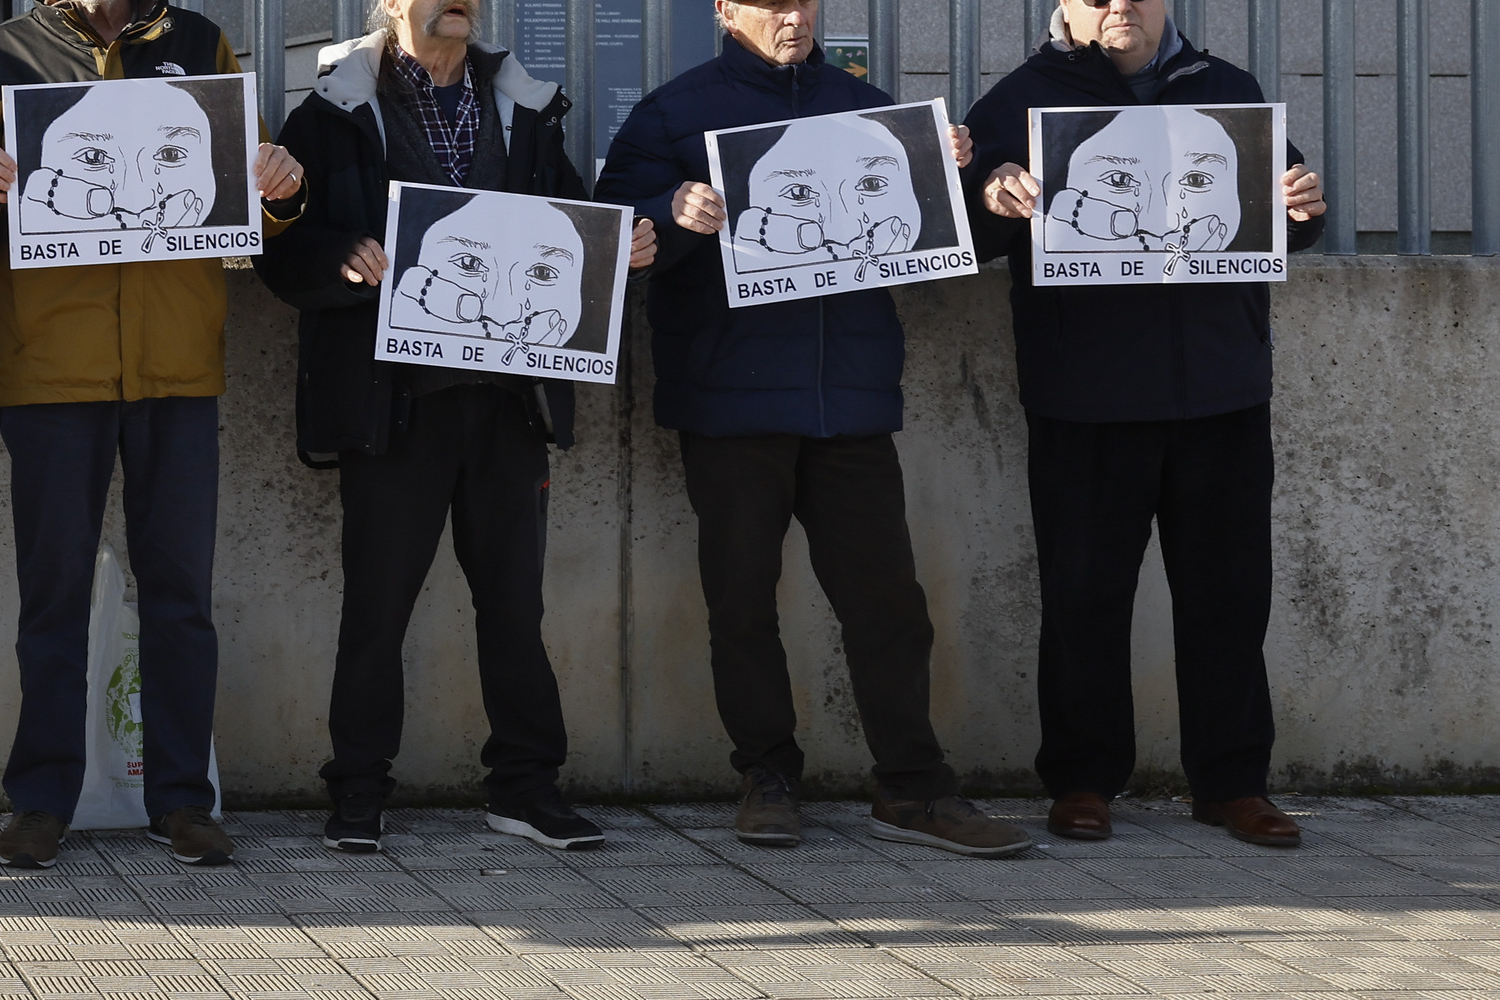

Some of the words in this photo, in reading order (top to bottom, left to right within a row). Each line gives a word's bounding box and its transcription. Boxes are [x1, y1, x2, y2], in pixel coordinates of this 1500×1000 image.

[21, 243, 79, 260] BASTA
[99, 240, 122, 255] DE
[166, 231, 260, 252] SILENCIOS
[738, 278, 796, 298] BASTA
[814, 271, 837, 287] DE
[879, 251, 974, 279] SILENCIOS
[1044, 262, 1101, 277] BASTA
[1122, 261, 1143, 276] DE
[1188, 257, 1283, 275] SILENCIOS
[387, 339, 443, 358] BASTA
[463, 346, 484, 362] DE
[527, 353, 613, 375] SILENCIOS
[127, 768, 145, 776] AMA
